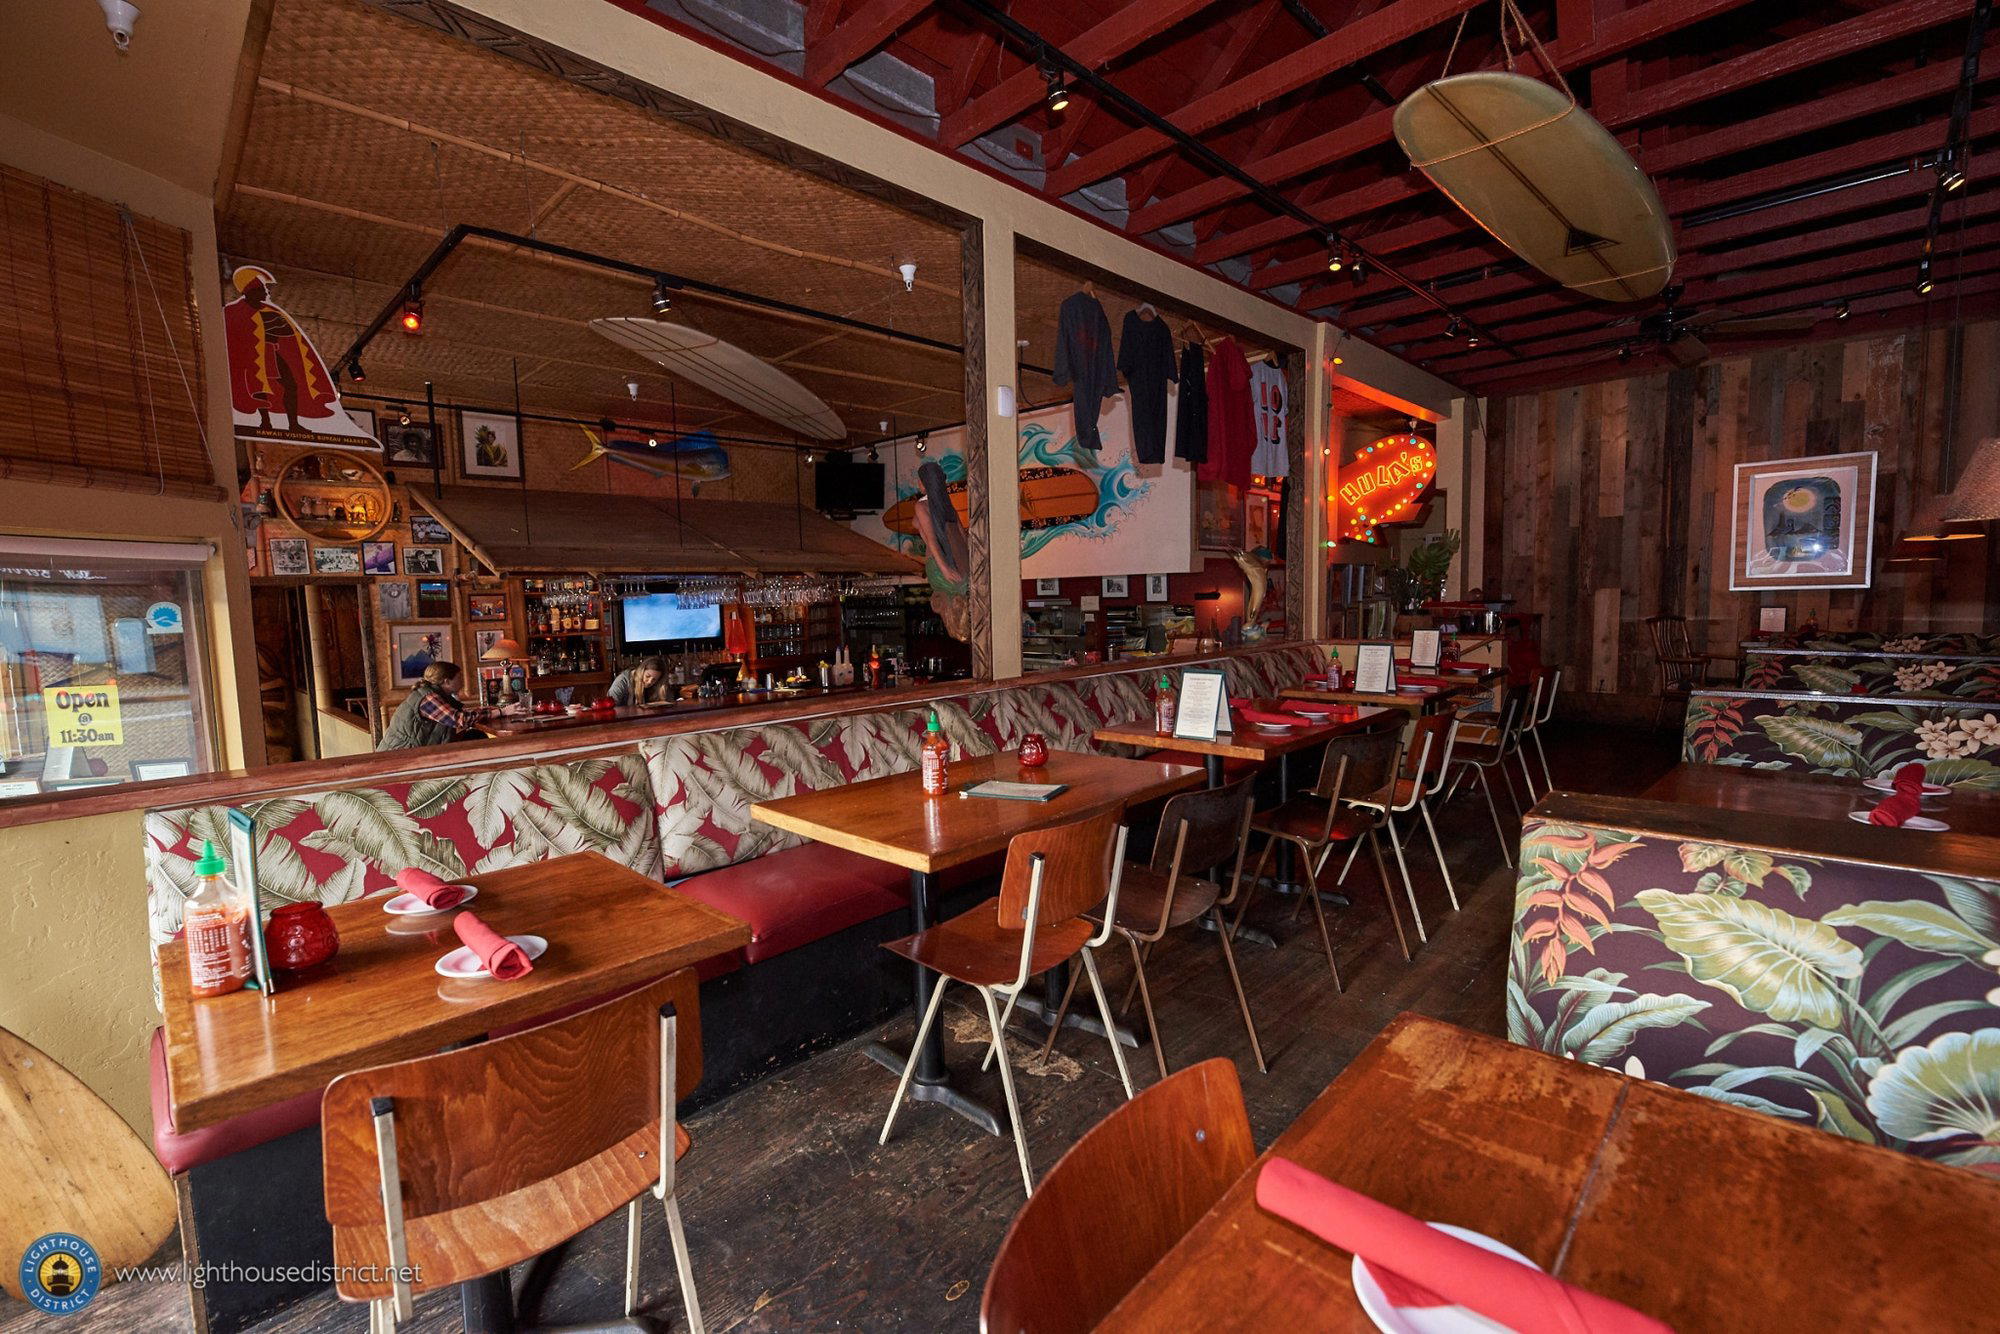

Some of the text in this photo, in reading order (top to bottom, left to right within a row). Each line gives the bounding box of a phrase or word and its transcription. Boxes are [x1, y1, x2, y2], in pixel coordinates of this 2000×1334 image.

[255, 429, 283, 437] HAWAII
[286, 432, 315, 440] VISITORS
[317, 435, 341, 443] BUREAU
[1339, 451, 1423, 506] HULA'S
[56, 690, 110, 712] Open
[60, 728, 115, 744] 11:30am
